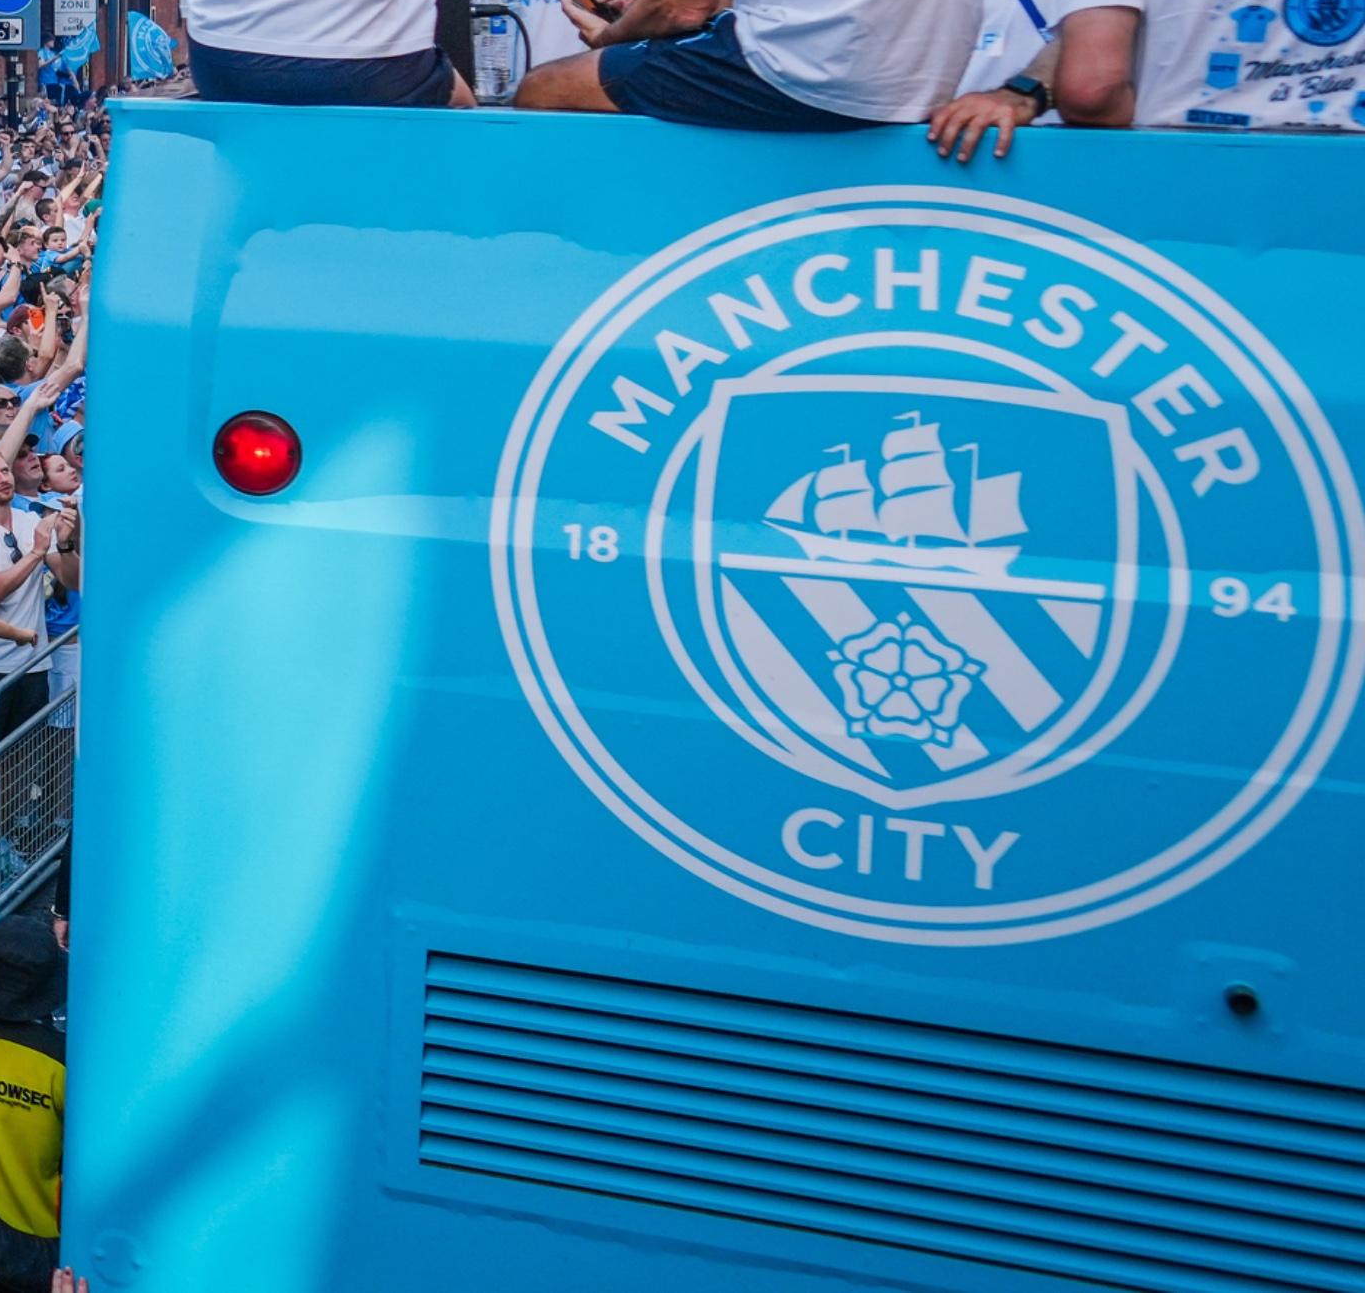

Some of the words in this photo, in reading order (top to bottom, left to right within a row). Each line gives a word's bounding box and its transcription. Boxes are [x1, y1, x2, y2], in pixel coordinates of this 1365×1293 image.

[60, 0, 90, 10] ZONE
[589, 247, 1261, 497] MANCHESTER
[563, 522, 620, 563] 18
[1208, 577, 1297, 622] 94
[780, 806, 1022, 891] CITY
